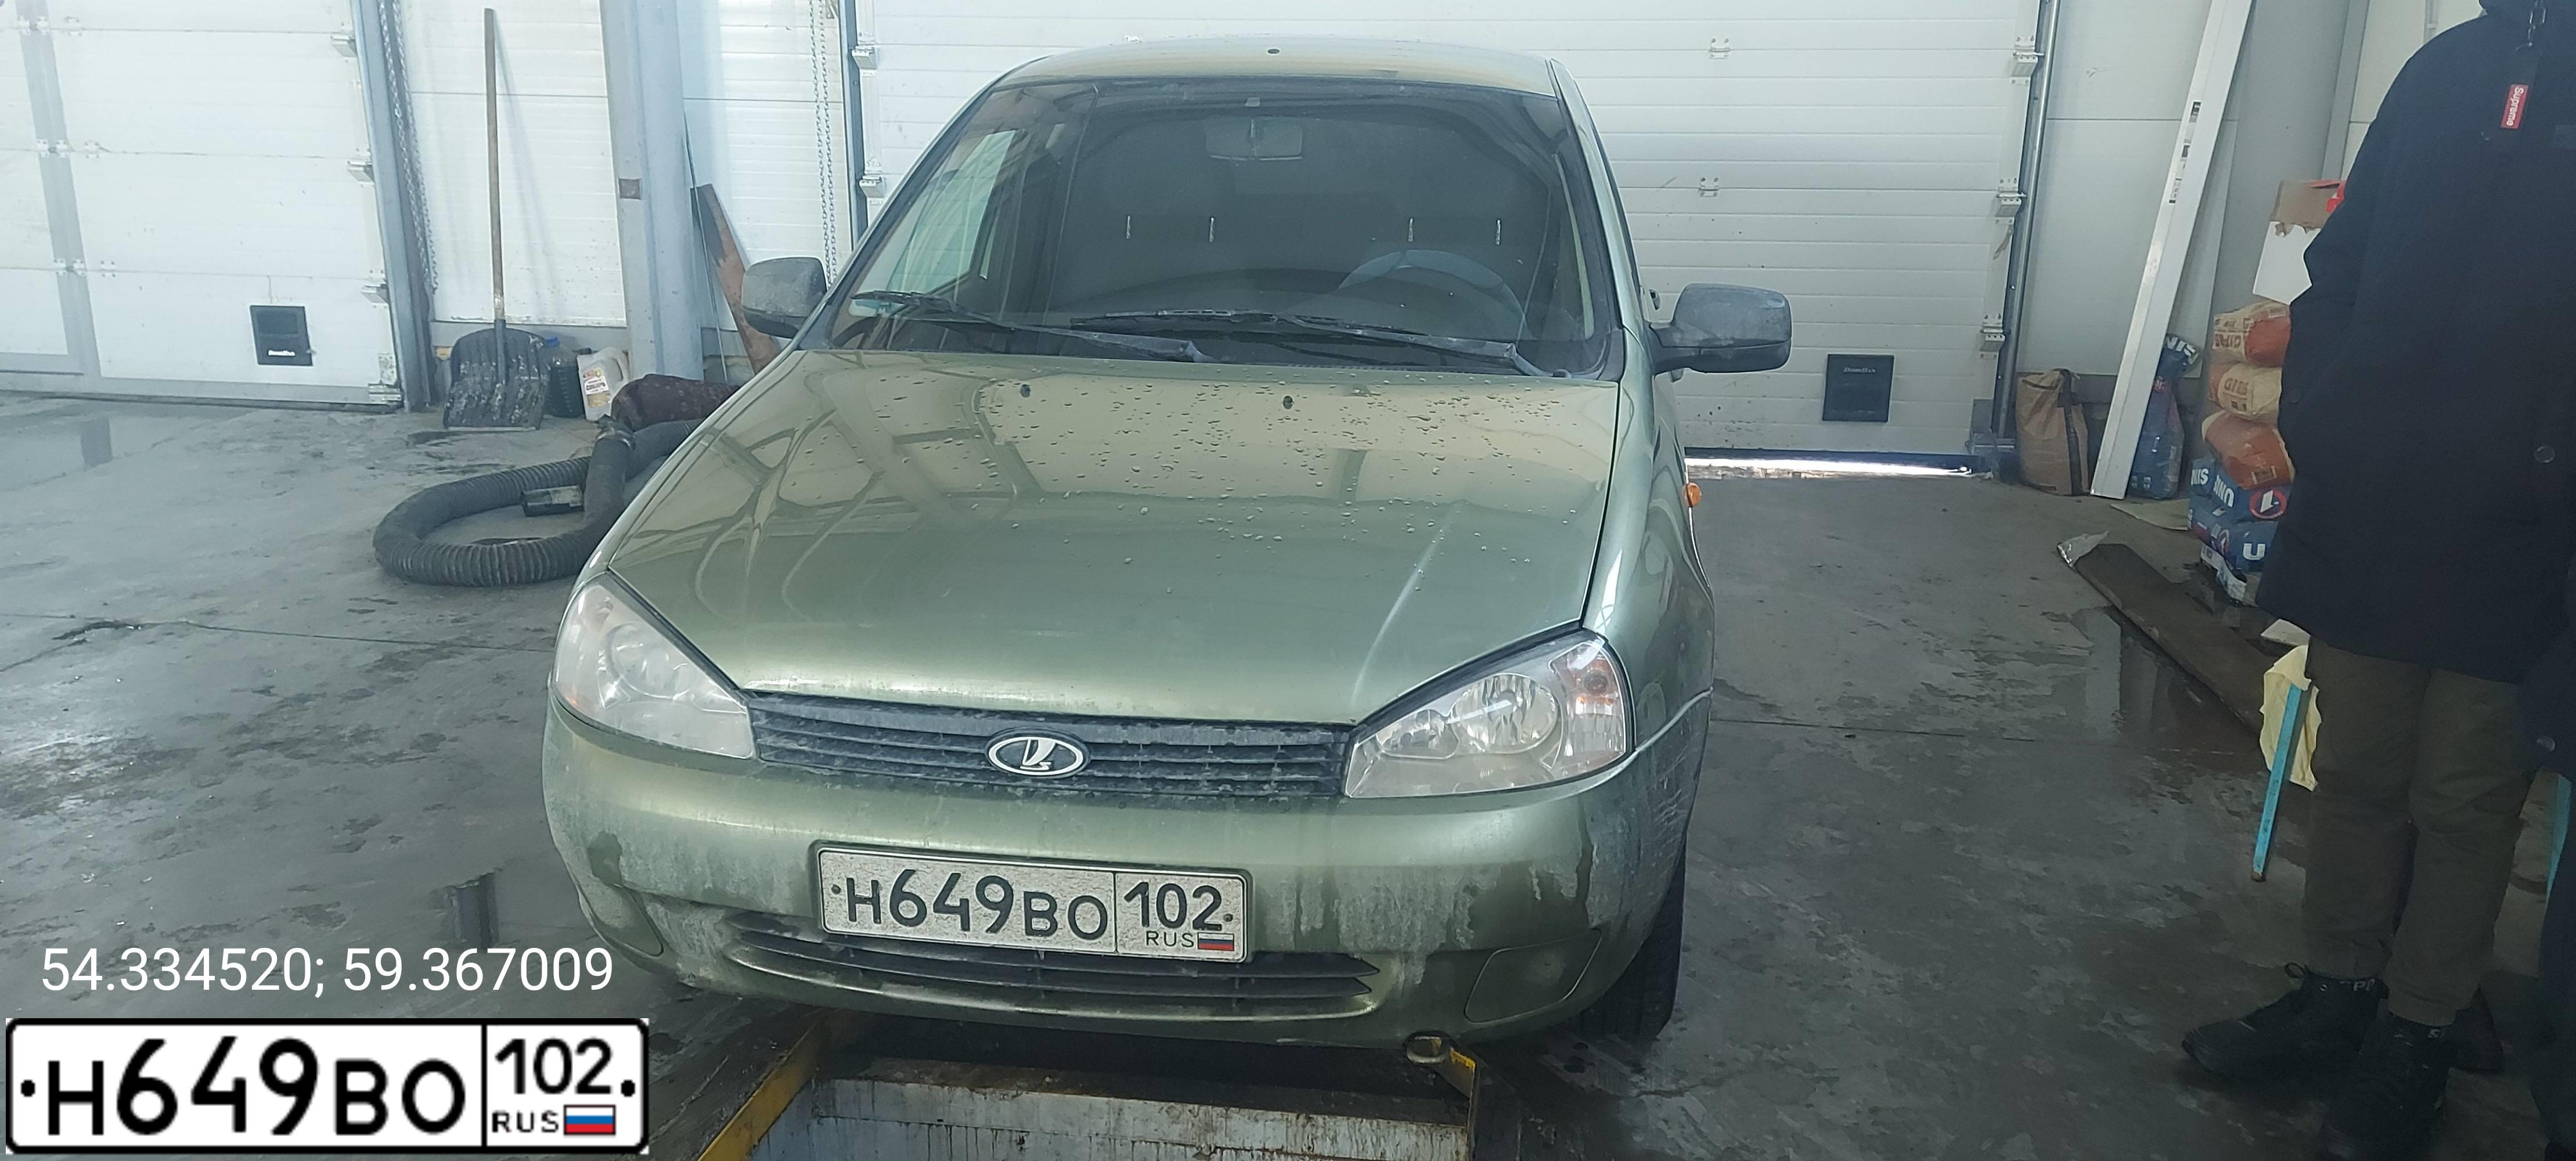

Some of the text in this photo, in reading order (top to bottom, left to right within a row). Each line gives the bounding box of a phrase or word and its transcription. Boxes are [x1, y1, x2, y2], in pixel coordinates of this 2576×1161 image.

[2506, 86, 2524, 127] Supreme
[845, 868, 1223, 940] Н649ВО 102
[1145, 930, 1195, 949] RUS
